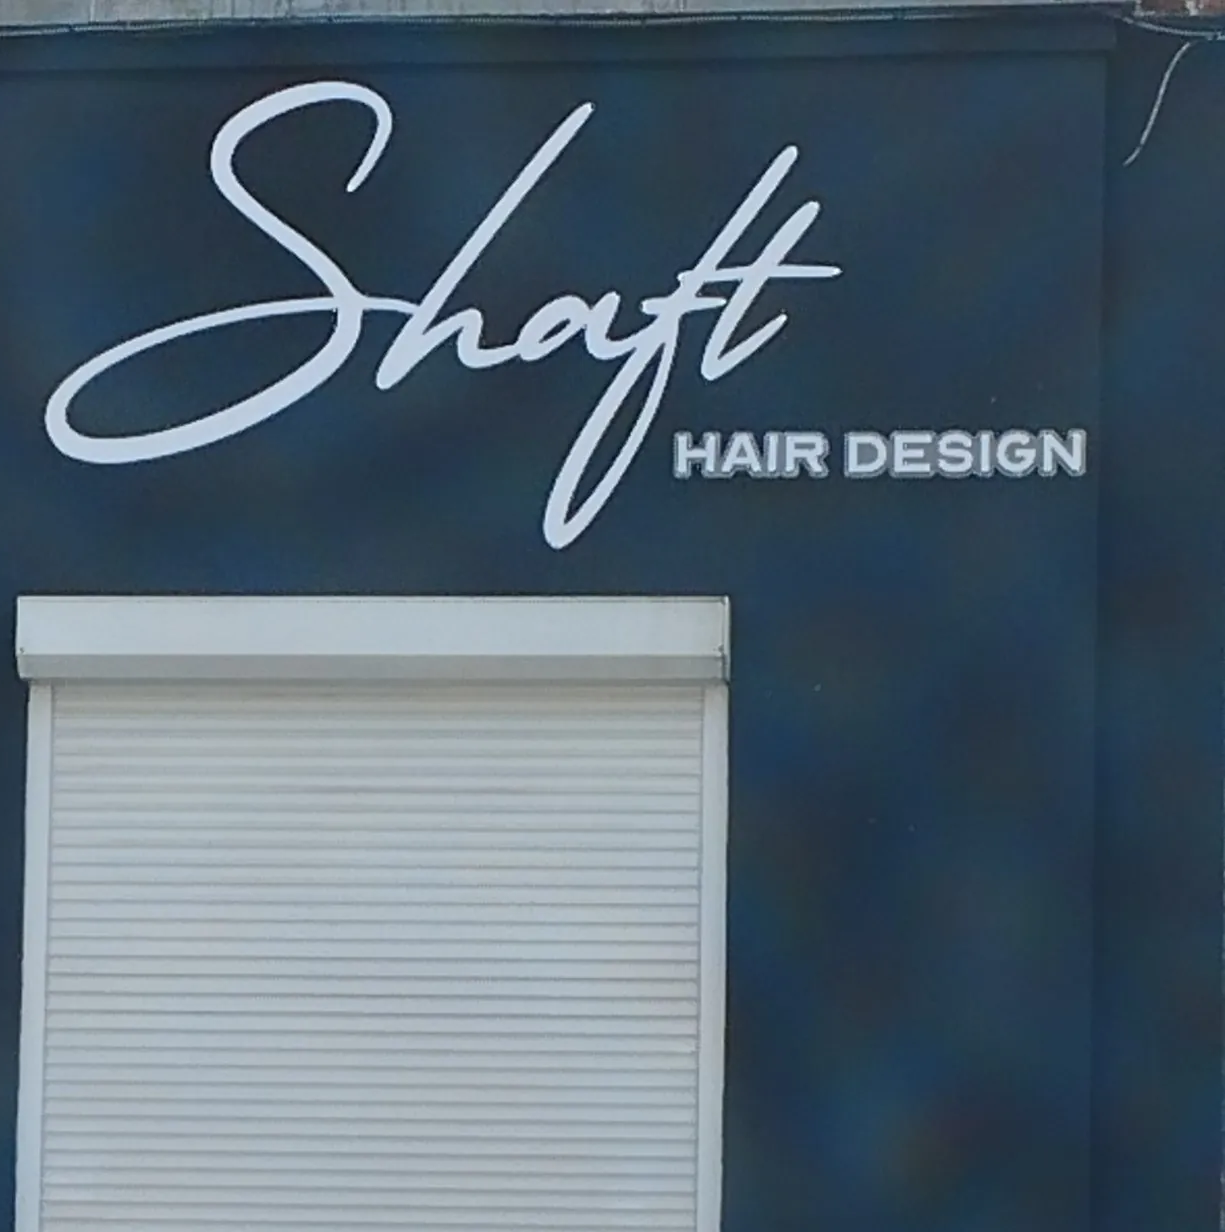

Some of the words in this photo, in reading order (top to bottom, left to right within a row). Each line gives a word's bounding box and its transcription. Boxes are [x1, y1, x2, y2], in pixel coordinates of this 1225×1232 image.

[44, 81, 842, 550] Shaft
[674, 430, 829, 478] HAIR
[844, 428, 1088, 478] DESIGN
